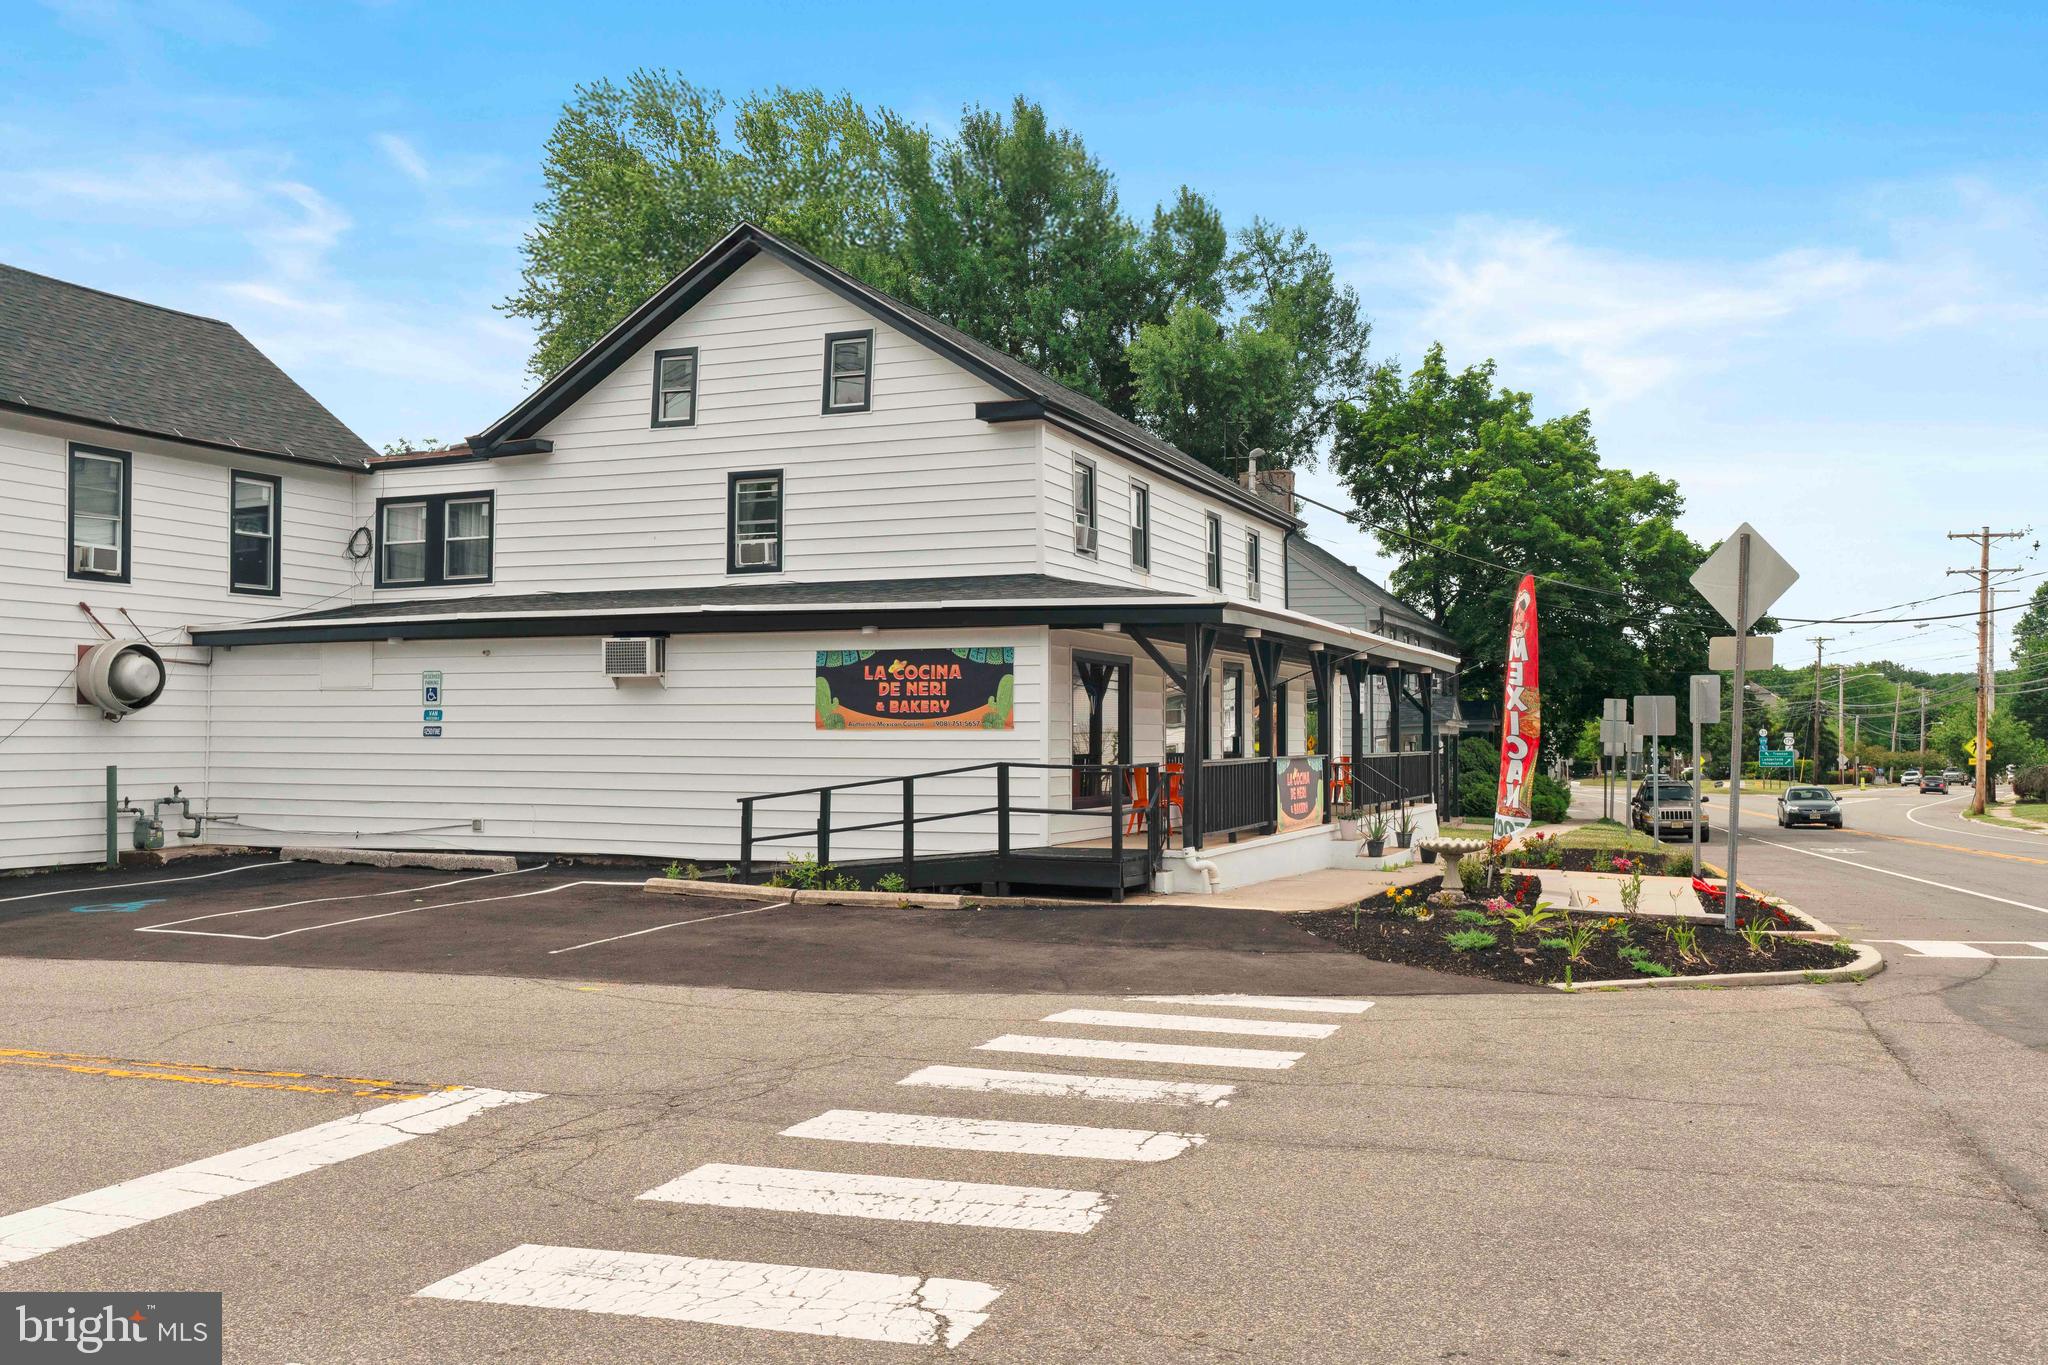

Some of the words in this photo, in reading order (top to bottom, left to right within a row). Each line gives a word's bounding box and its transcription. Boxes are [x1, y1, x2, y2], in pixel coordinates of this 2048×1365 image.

[864, 665, 887, 681] LA
[892, 664, 962, 680] COCINA
[878, 682, 901, 697] DE
[906, 681, 947, 696] NERI
[875, 701, 885, 712] &
[889, 700, 950, 713] BAKERY
[1286, 773, 1293, 786] LA
[1293, 771, 1310, 786] COCINA
[1290, 787, 1296, 800] DE
